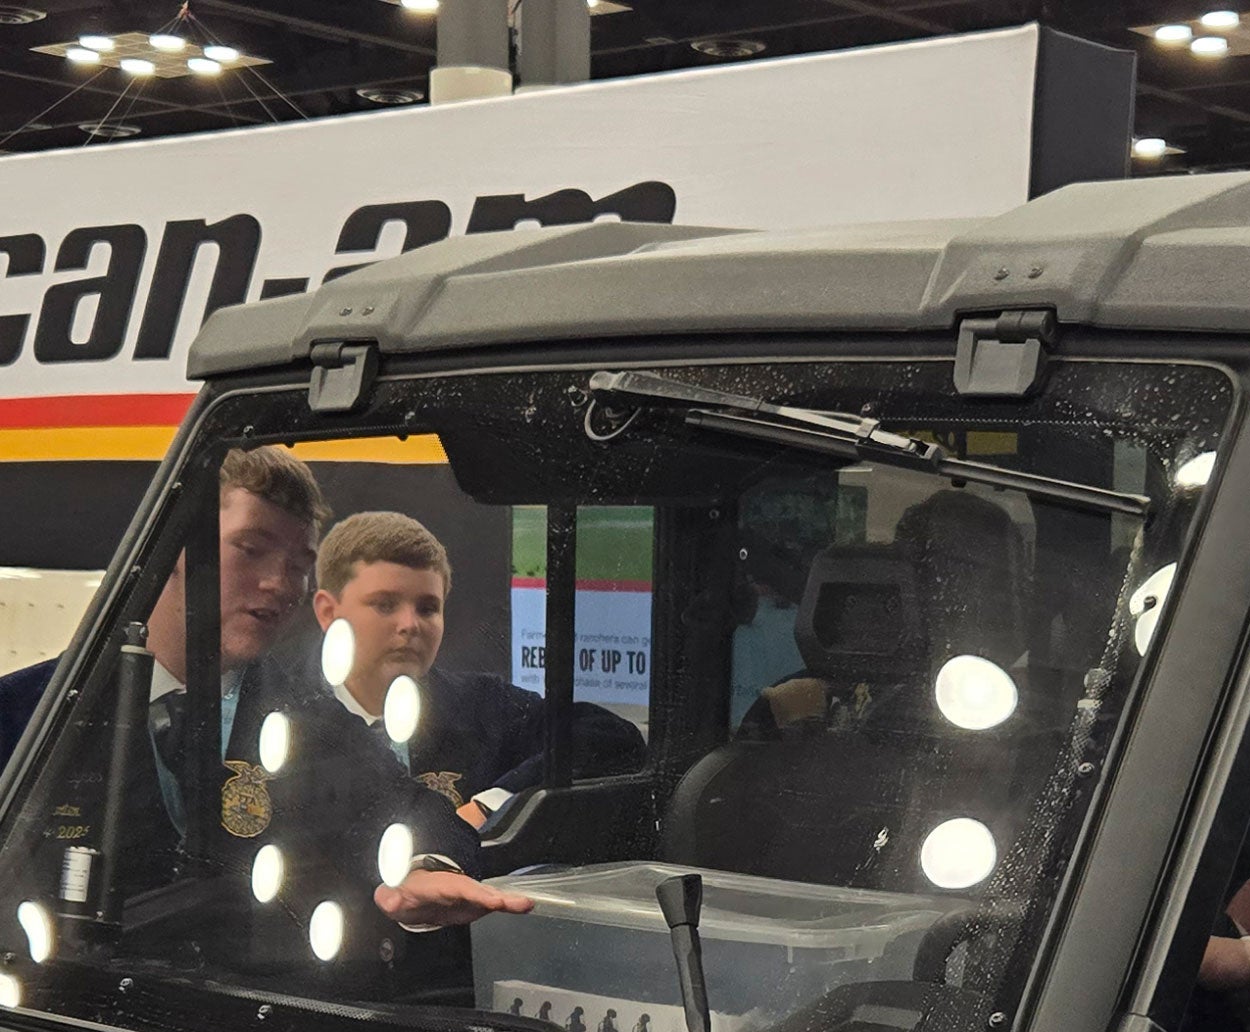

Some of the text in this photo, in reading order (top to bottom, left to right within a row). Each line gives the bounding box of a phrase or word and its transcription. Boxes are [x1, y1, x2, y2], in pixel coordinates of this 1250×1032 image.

[521, 646, 647, 676] REB OF UP TO
